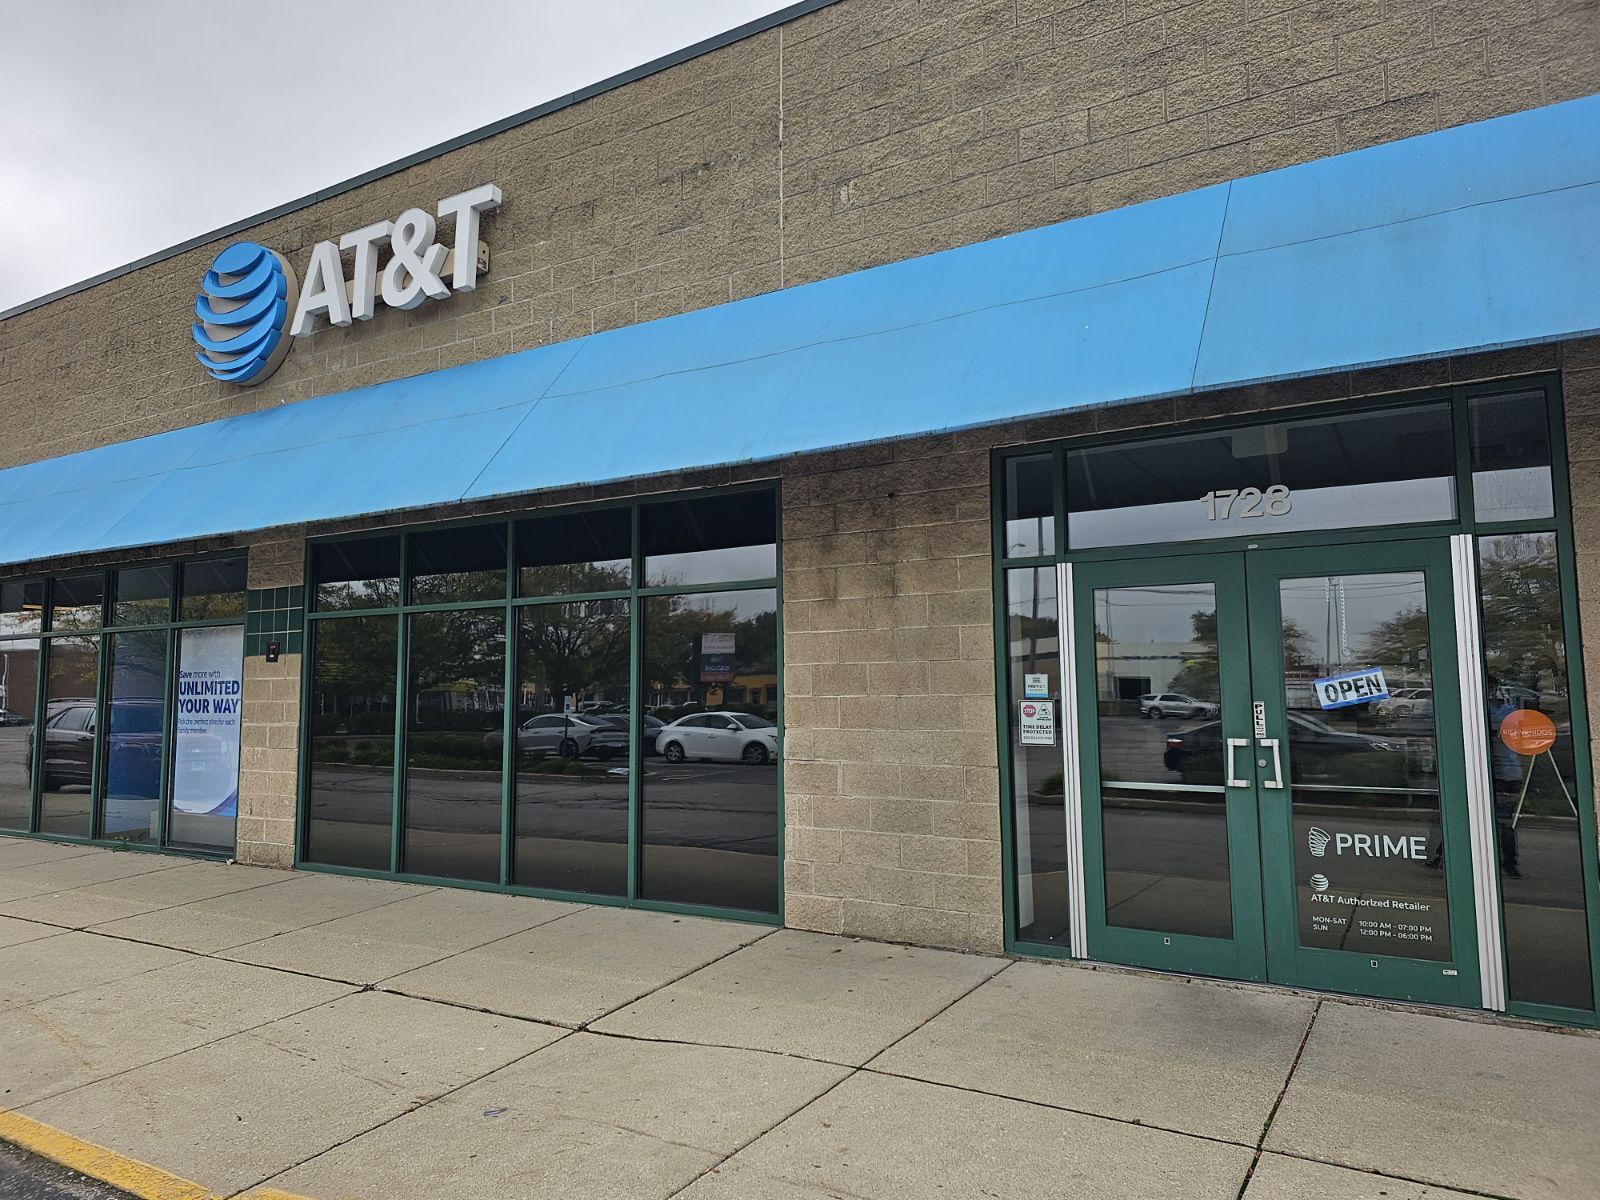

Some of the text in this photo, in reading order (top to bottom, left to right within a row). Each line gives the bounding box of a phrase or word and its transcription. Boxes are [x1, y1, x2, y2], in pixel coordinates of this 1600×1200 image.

[290, 183, 502, 338] AT&T
[1200, 484, 1292, 521] 1728
[208, 670, 220, 678] with
[179, 680, 240, 696] UNLIMITED
[1324, 673, 1383, 703] OPEN
[178, 698, 239, 714] YOUR WAY
[1254, 704, 1264, 726] PULL
[1335, 833, 1428, 860] PRIME
[1311, 894, 1430, 912] AT&T Authorized Retailer
[1312, 916, 1347, 925] MON-SAT
[1358, 920, 1378, 928] 10:00
[1379, 922, 1392, 930] AM
[1398, 924, 1418, 932] 07:00
[1360, 928, 1378, 936] 12:00
[1380, 930, 1392, 938] PM
